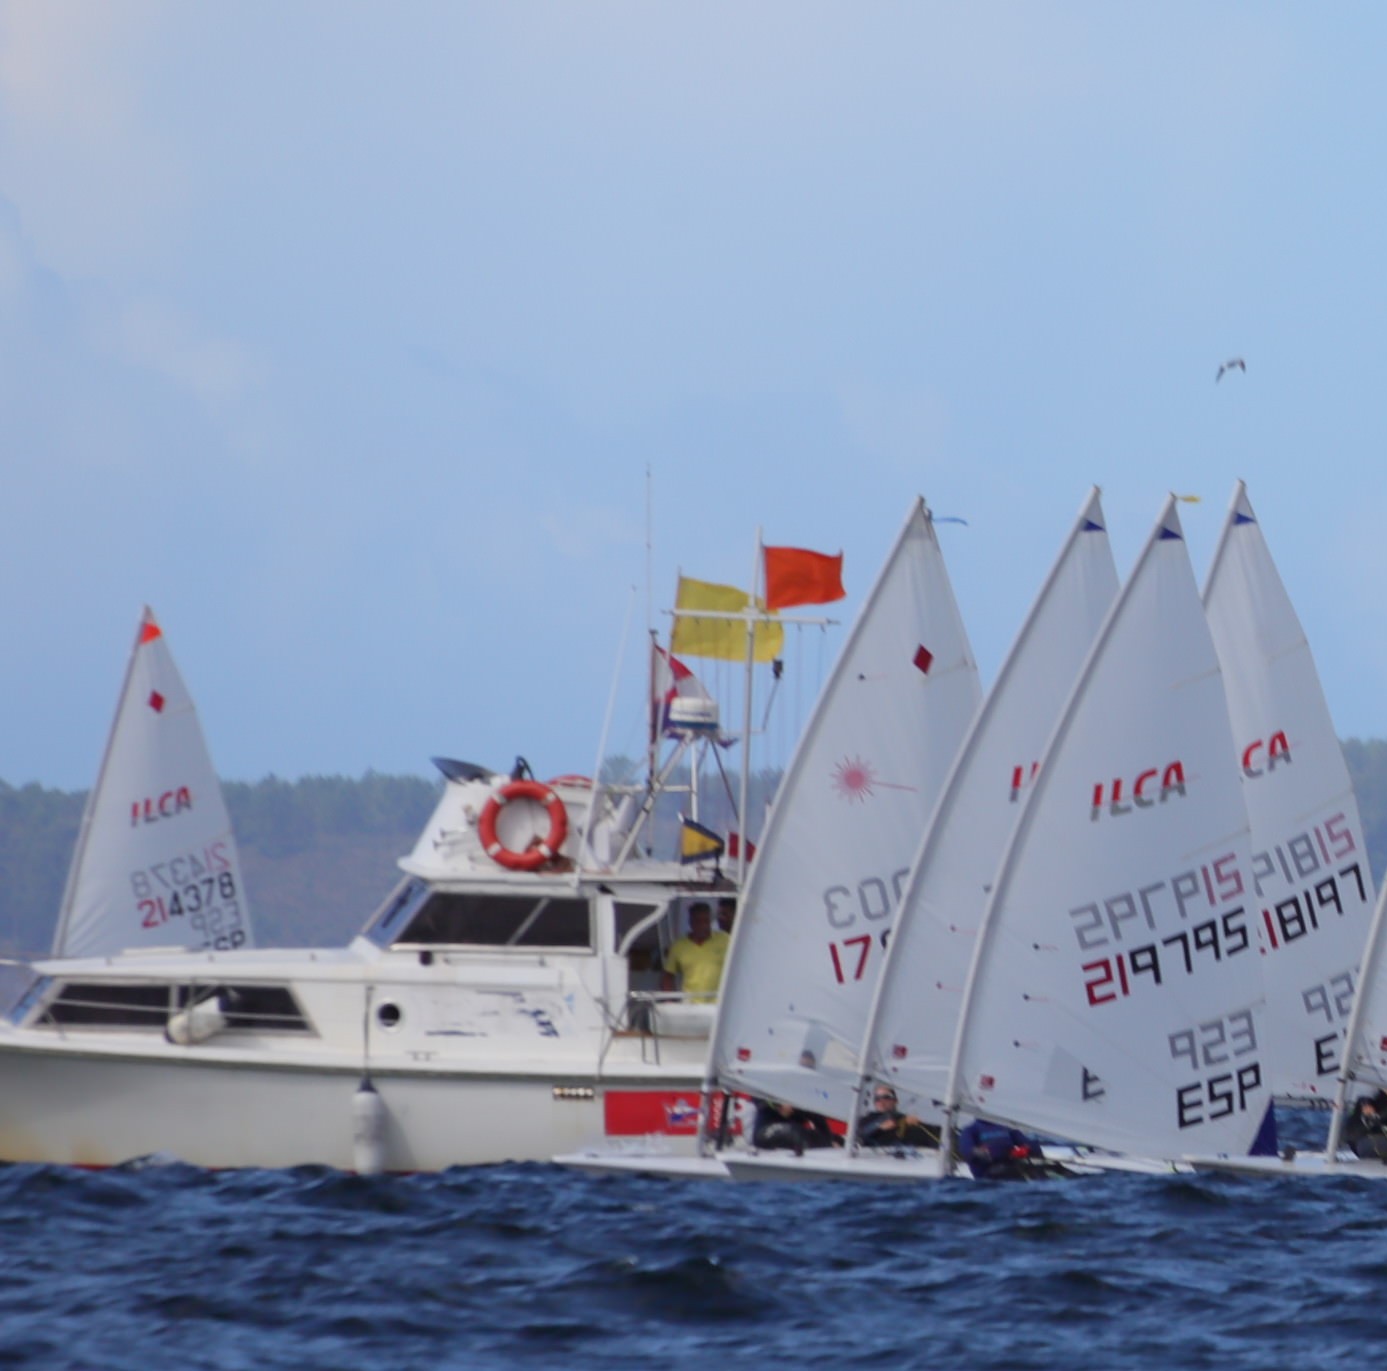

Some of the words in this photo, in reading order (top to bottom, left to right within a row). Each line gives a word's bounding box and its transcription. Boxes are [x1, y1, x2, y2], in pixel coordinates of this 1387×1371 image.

[1241, 729, 1292, 779] CA
[131, 785, 192, 828] ILCA
[1090, 760, 1187, 822] ILCA
[137, 871, 236, 929] 214378
[1257, 861, 1368, 956] 18197
[1081, 905, 1250, 1007] 219795
[1177, 1061, 1262, 1130] ESP
